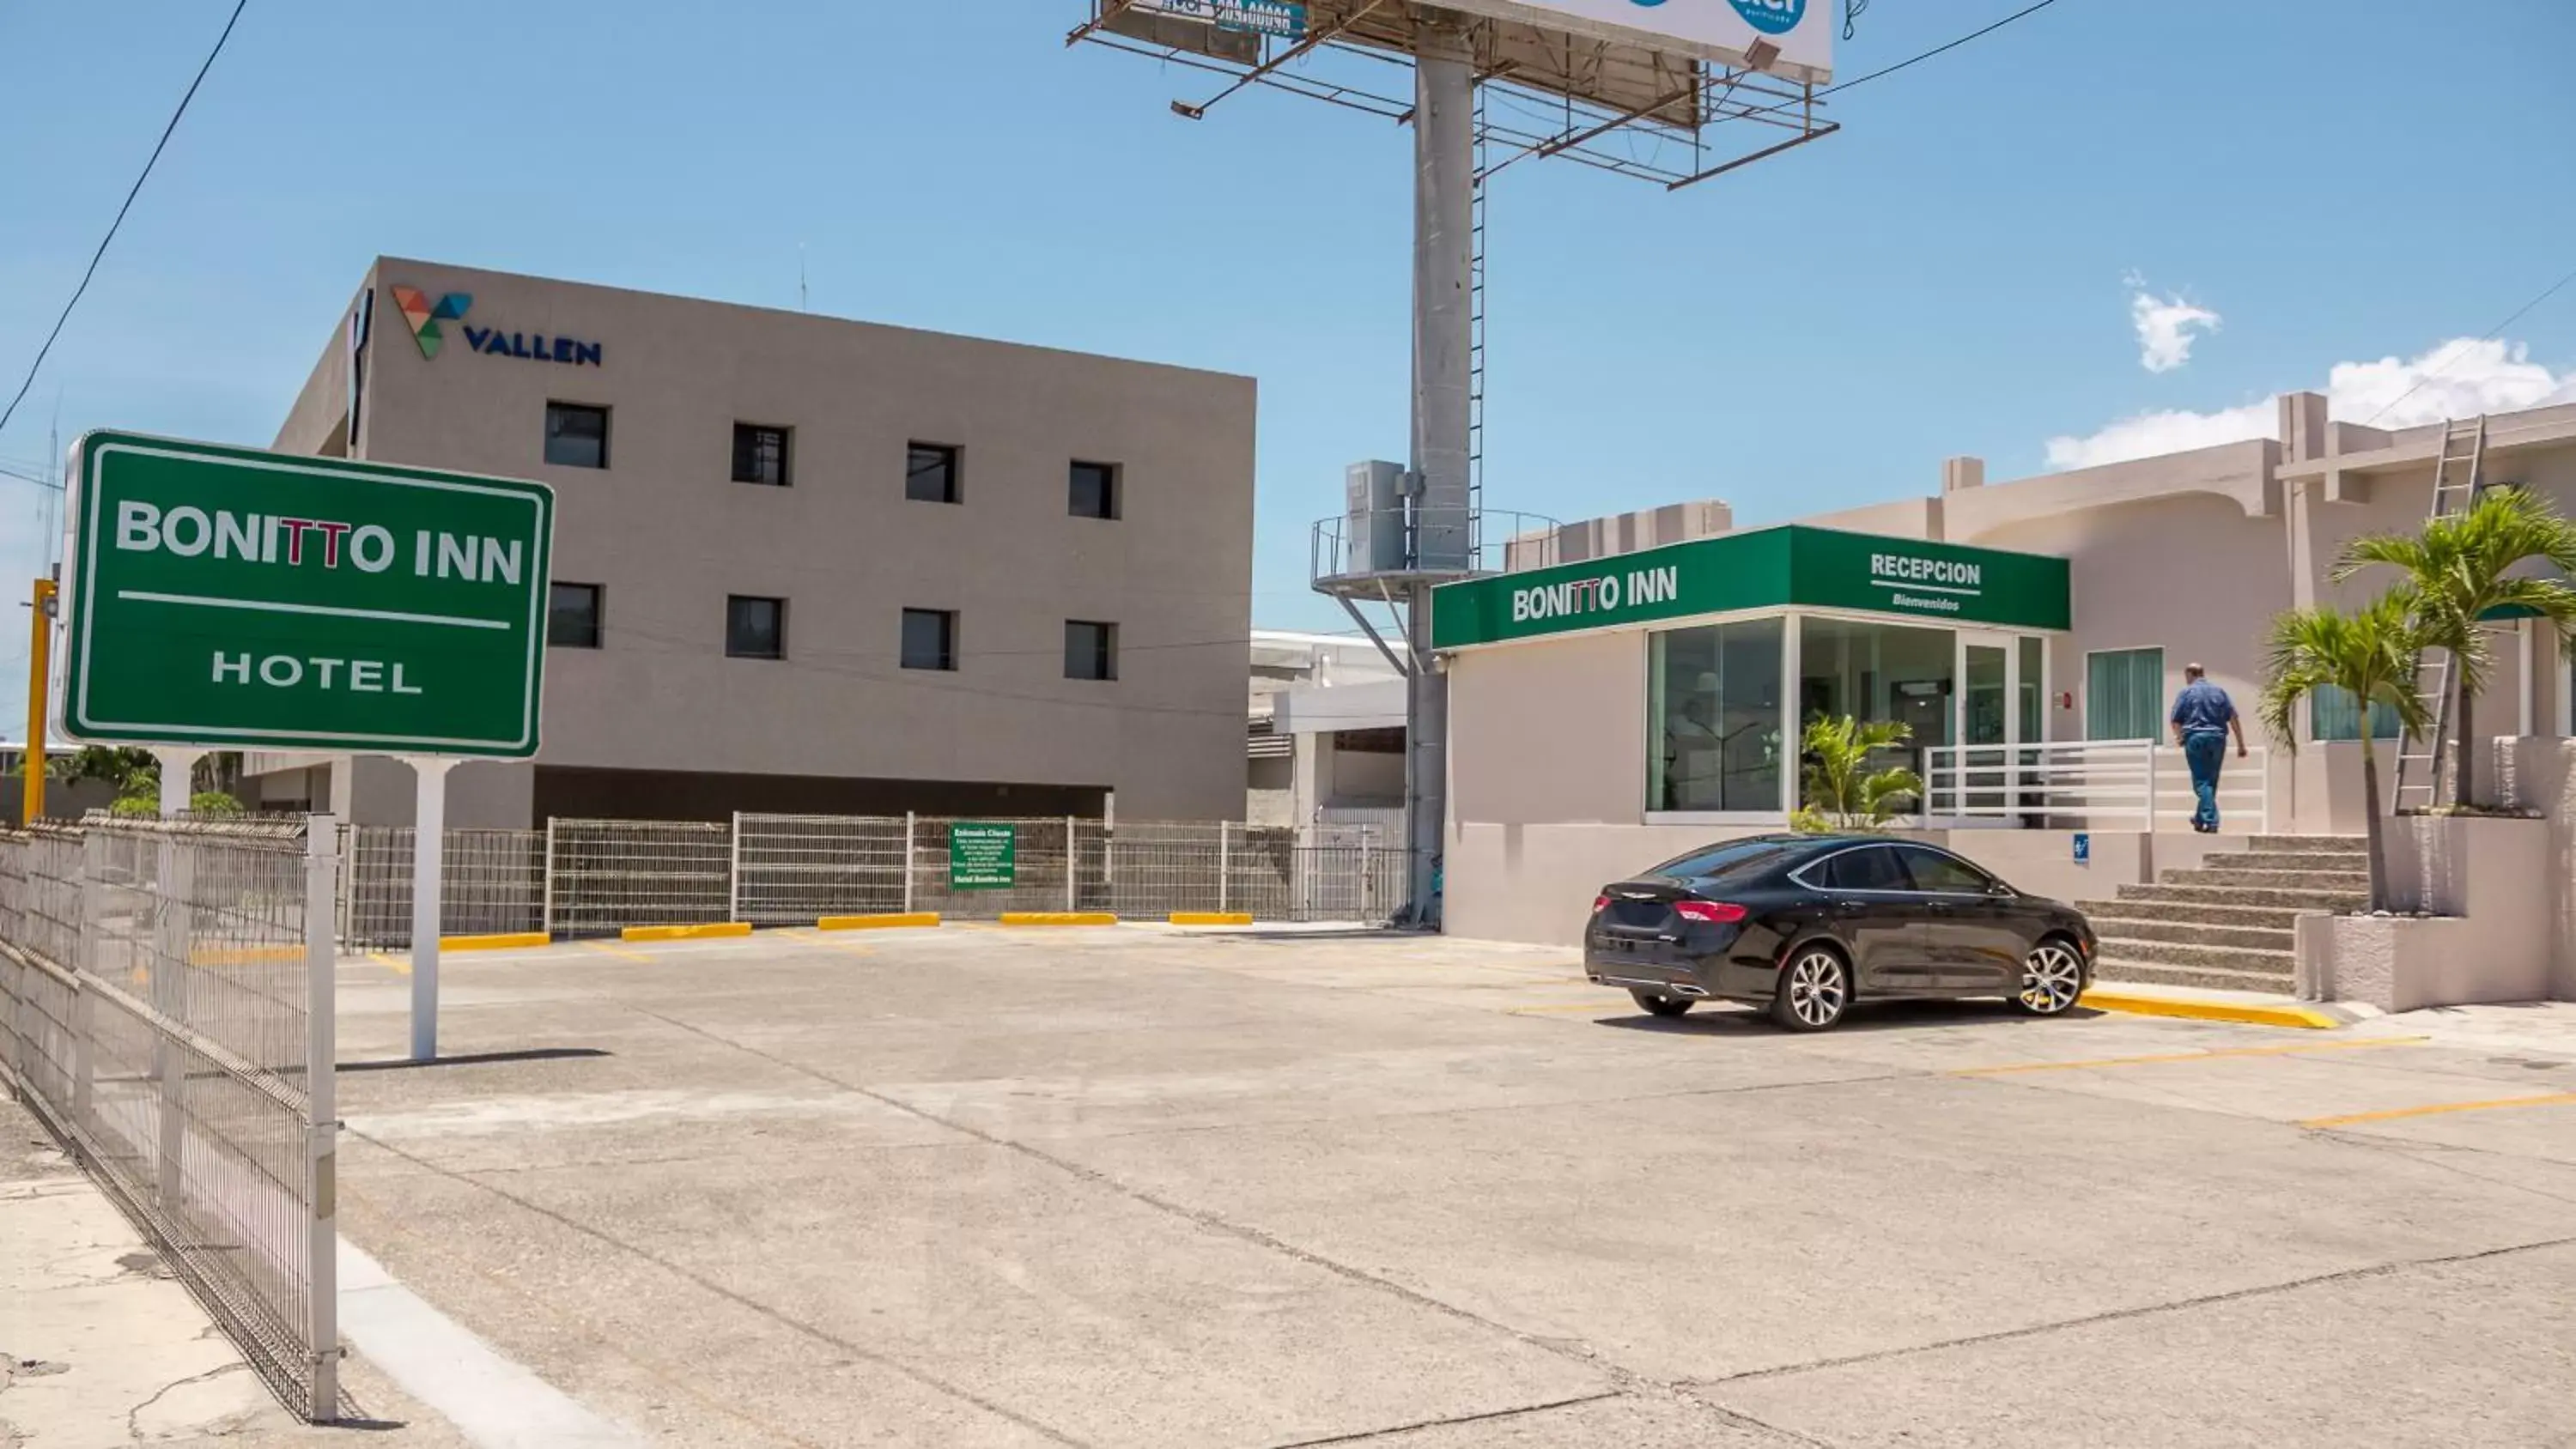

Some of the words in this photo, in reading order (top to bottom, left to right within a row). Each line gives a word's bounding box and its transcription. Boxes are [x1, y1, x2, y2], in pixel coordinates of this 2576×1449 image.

[463, 324, 602, 367] VALLEN
[116, 500, 395, 573] BONITTO
[415, 530, 522, 585] INN
[1513, 575, 1620, 622] BONITTO
[1627, 566, 1677, 606] INN
[1893, 593, 1960, 612] Bienvenidos
[211, 651, 422, 694] HOTEL
